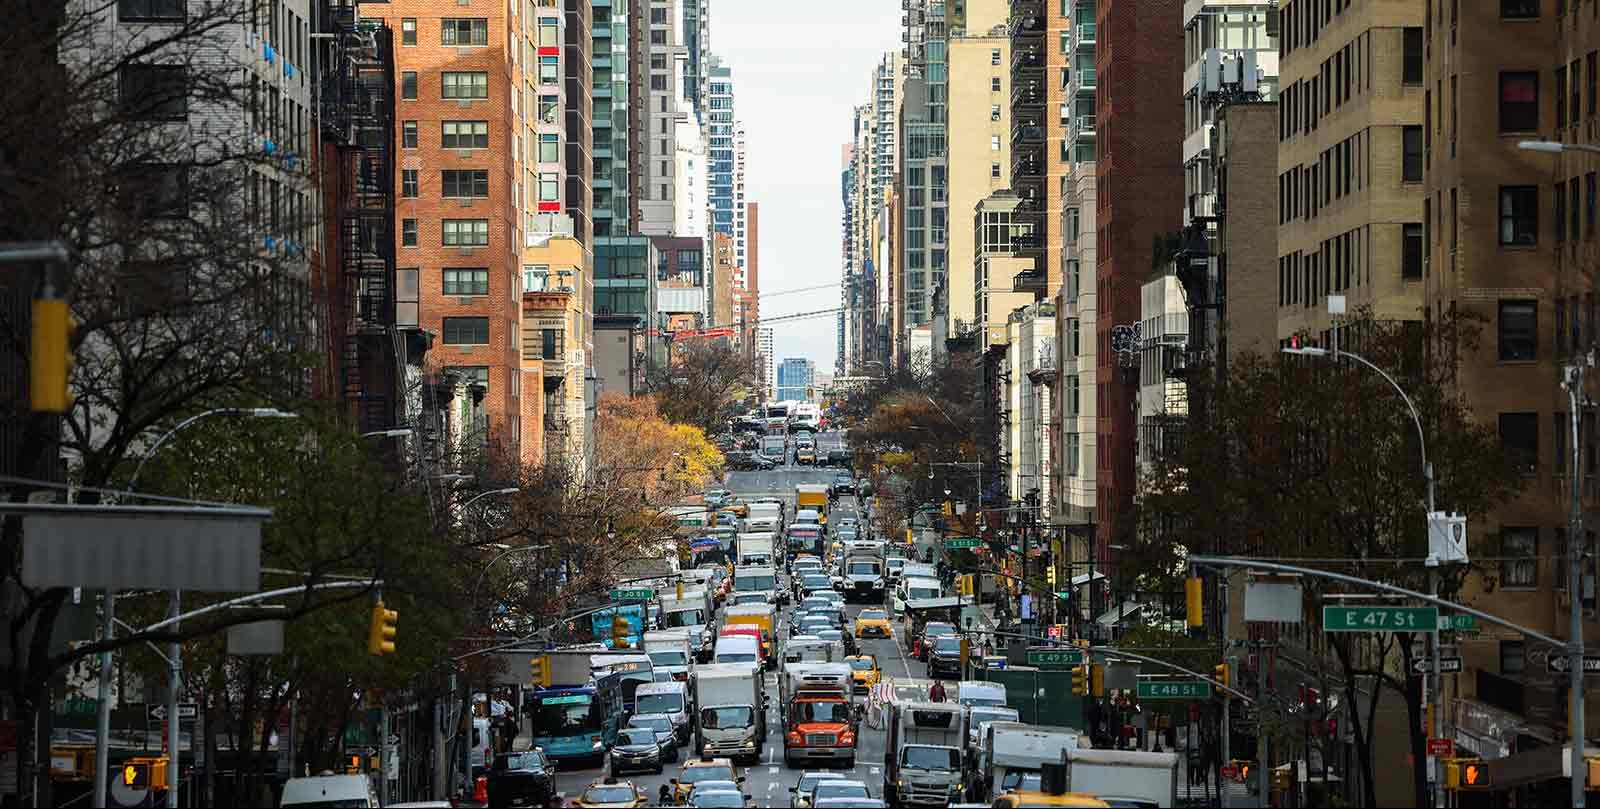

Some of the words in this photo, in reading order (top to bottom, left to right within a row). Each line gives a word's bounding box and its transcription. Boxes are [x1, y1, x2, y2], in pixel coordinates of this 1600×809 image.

[1346, 611, 1357, 625] E
[1363, 611, 1387, 626] 47
[1394, 611, 1415, 626] St
[1039, 654, 1045, 662] E
[1151, 685, 1158, 695] E
[1161, 685, 1179, 695] 48
[1183, 685, 1196, 695] St
